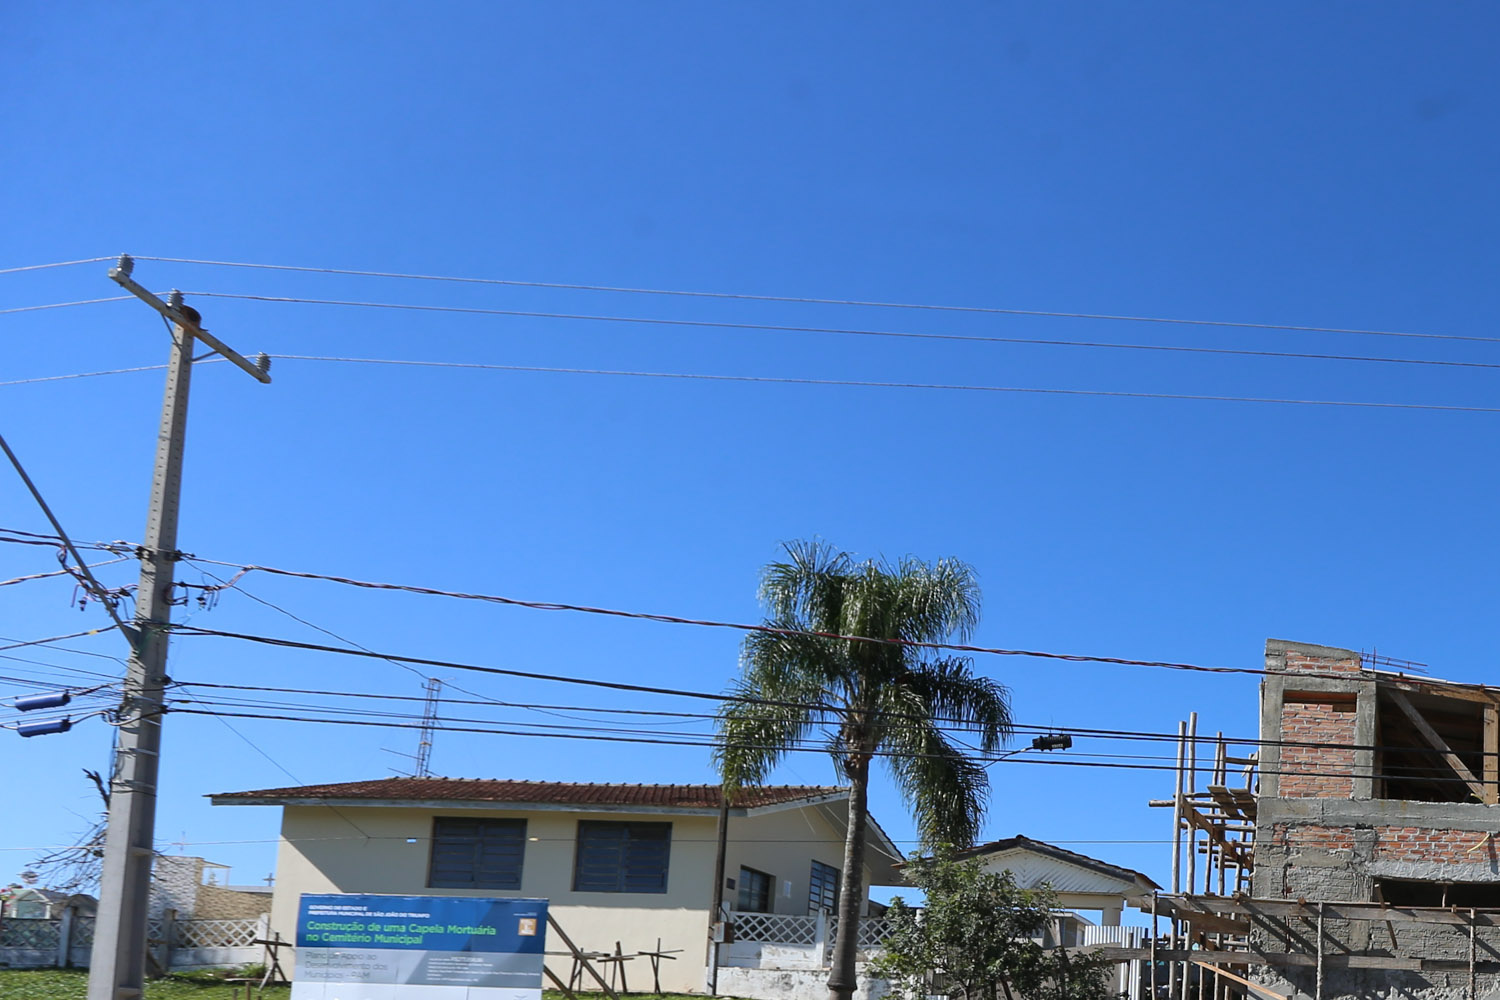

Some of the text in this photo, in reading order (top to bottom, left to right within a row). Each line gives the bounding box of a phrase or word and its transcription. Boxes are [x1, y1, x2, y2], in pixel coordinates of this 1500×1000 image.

[306, 920, 497, 936] Construção de uma Capela Mortuária
[305, 932, 423, 945] no Cemitério Municipal
